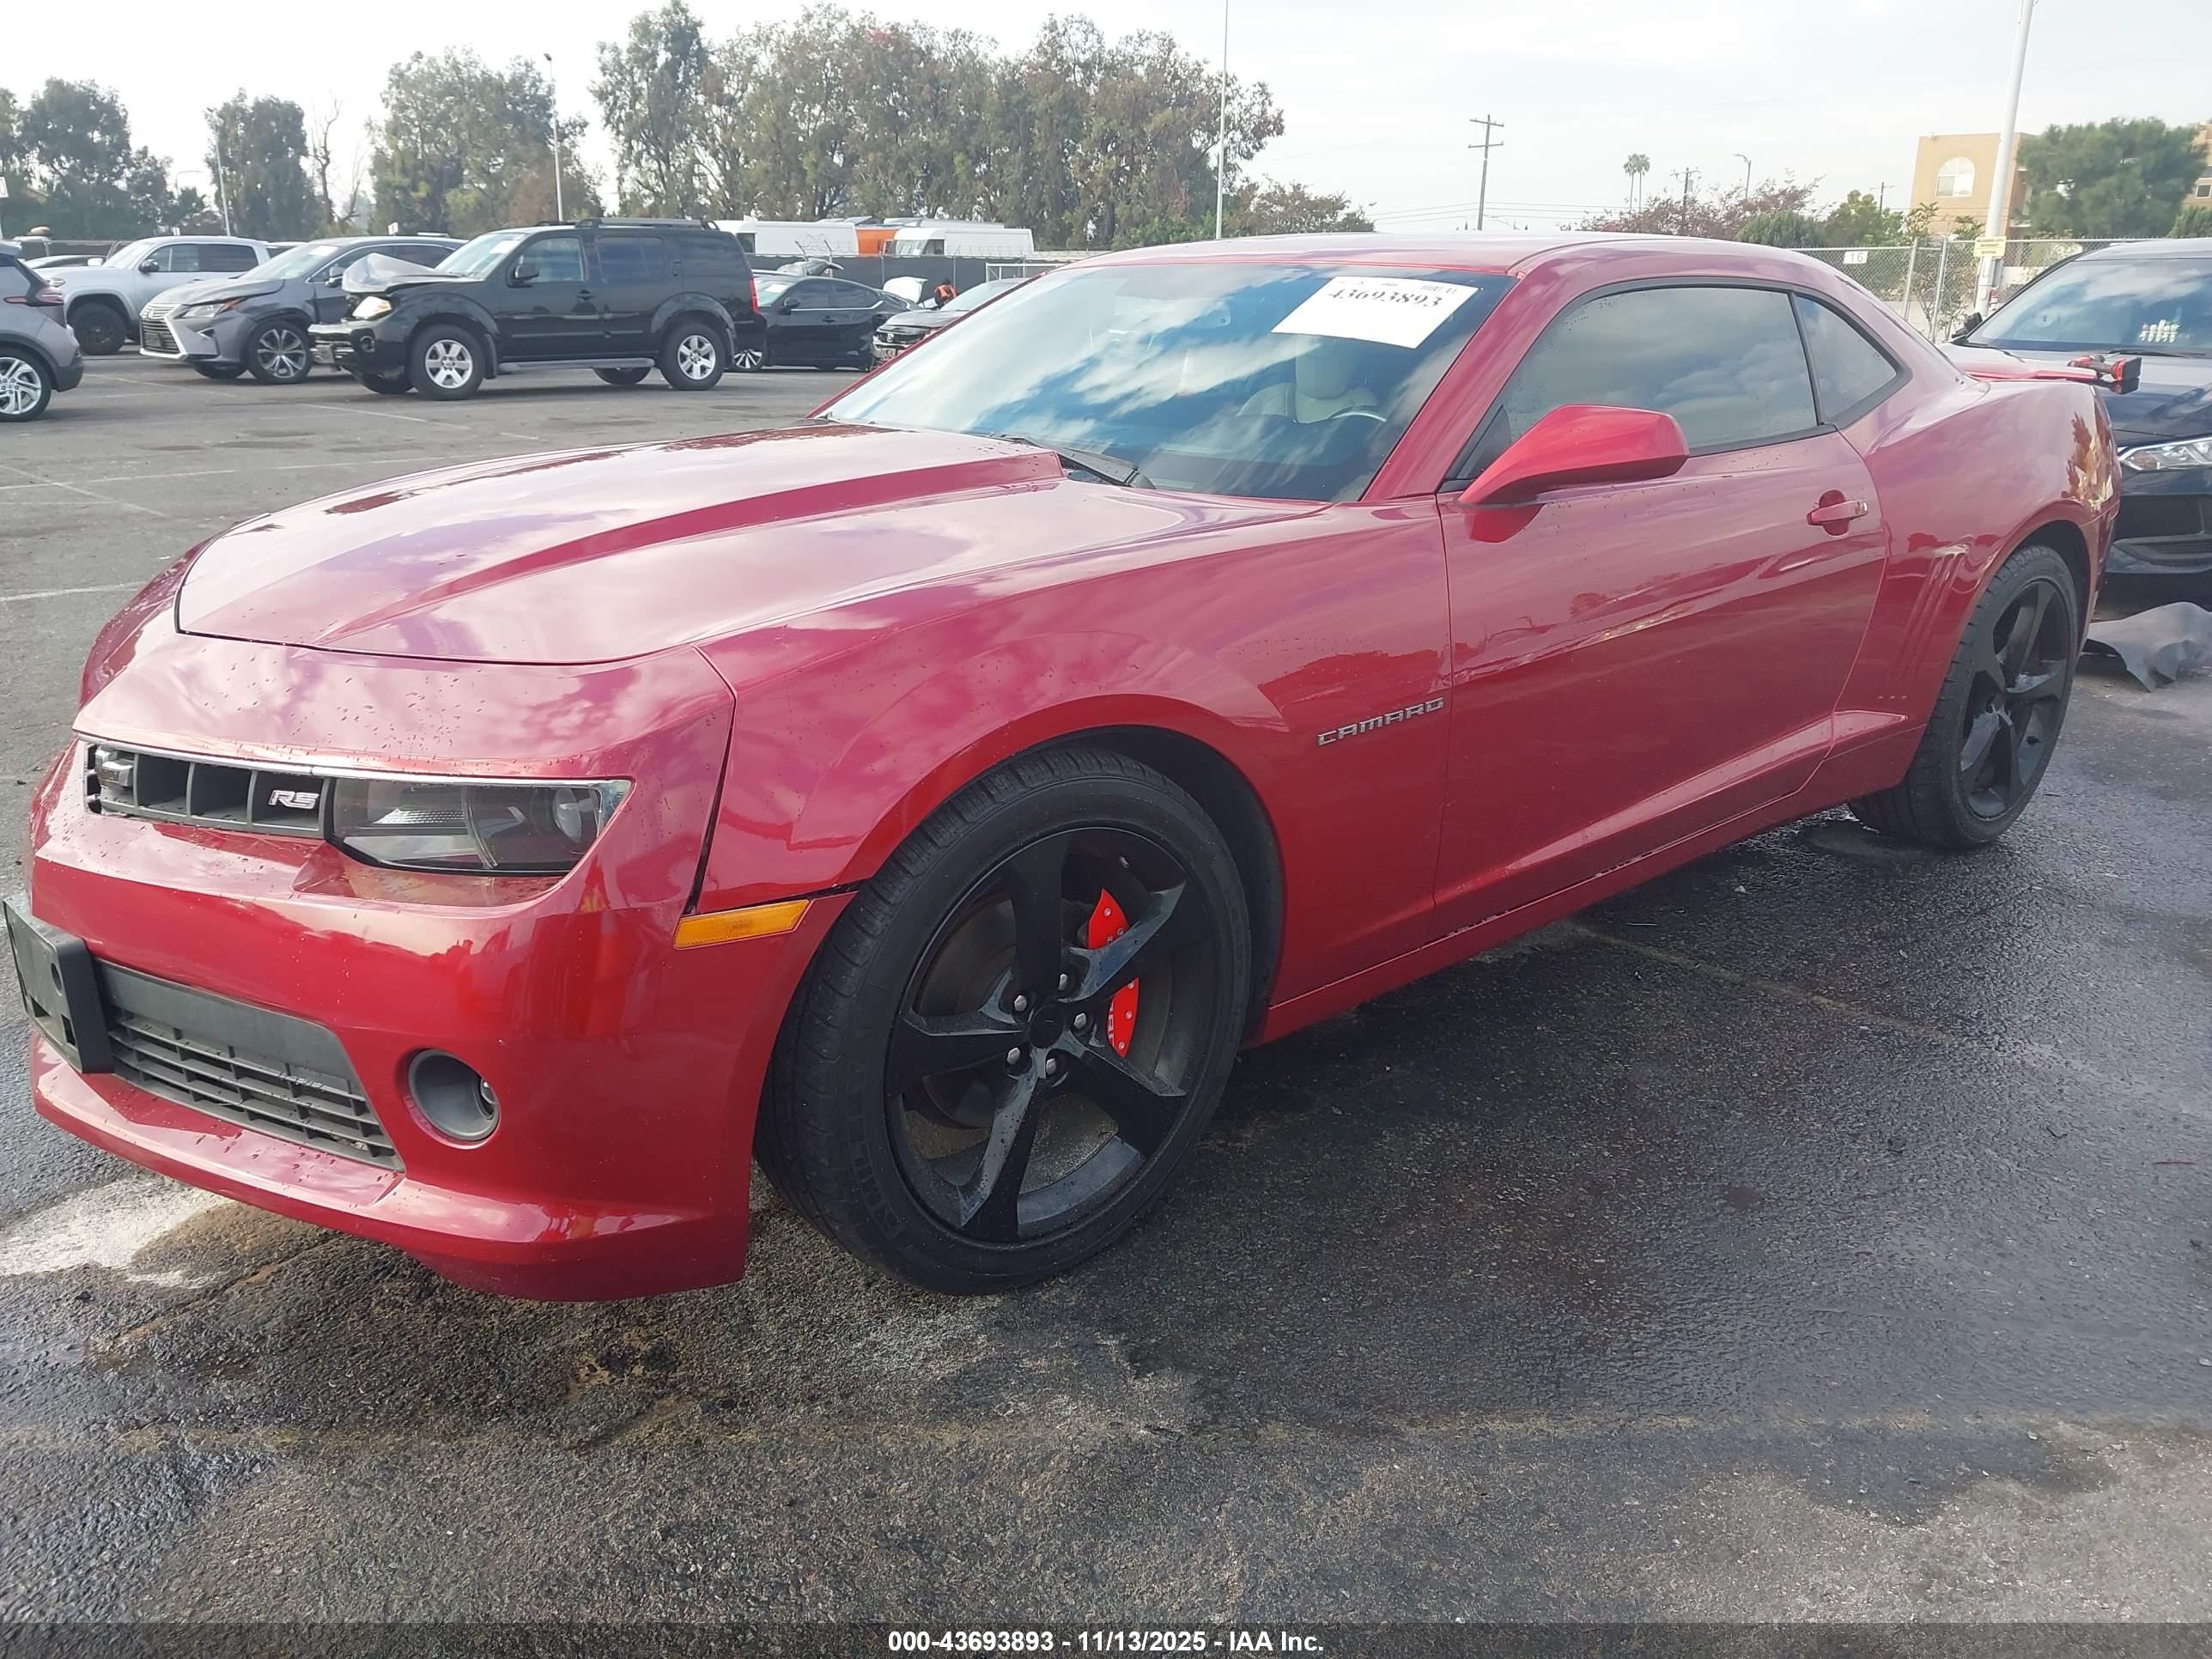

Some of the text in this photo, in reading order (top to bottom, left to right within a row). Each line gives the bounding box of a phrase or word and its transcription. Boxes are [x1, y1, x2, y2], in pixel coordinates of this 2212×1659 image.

[1328, 288, 1443, 307] 43693893
[1318, 697, 1443, 745] CAMARO
[268, 789, 319, 809] RS
